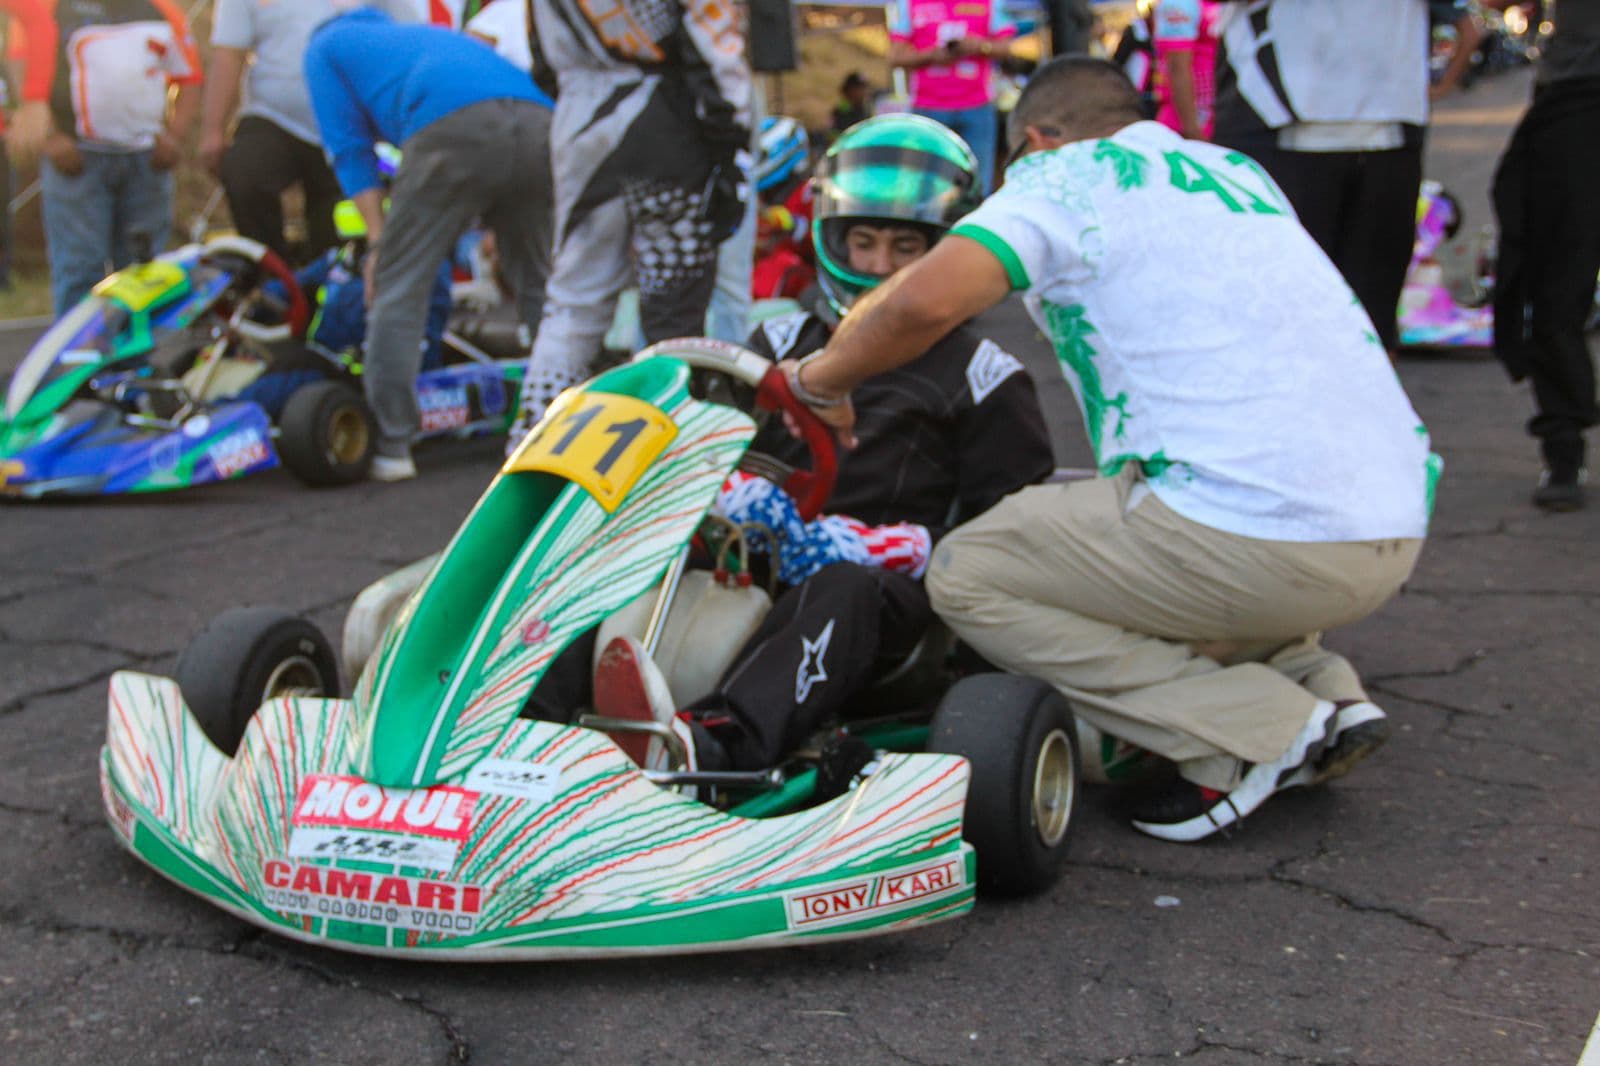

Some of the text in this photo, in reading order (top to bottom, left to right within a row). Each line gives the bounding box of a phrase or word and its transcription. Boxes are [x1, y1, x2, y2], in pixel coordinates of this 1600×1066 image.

[299, 779, 465, 831] MOTUL
[263, 860, 481, 913] CAMARI
[793, 861, 957, 918] TONY KART
